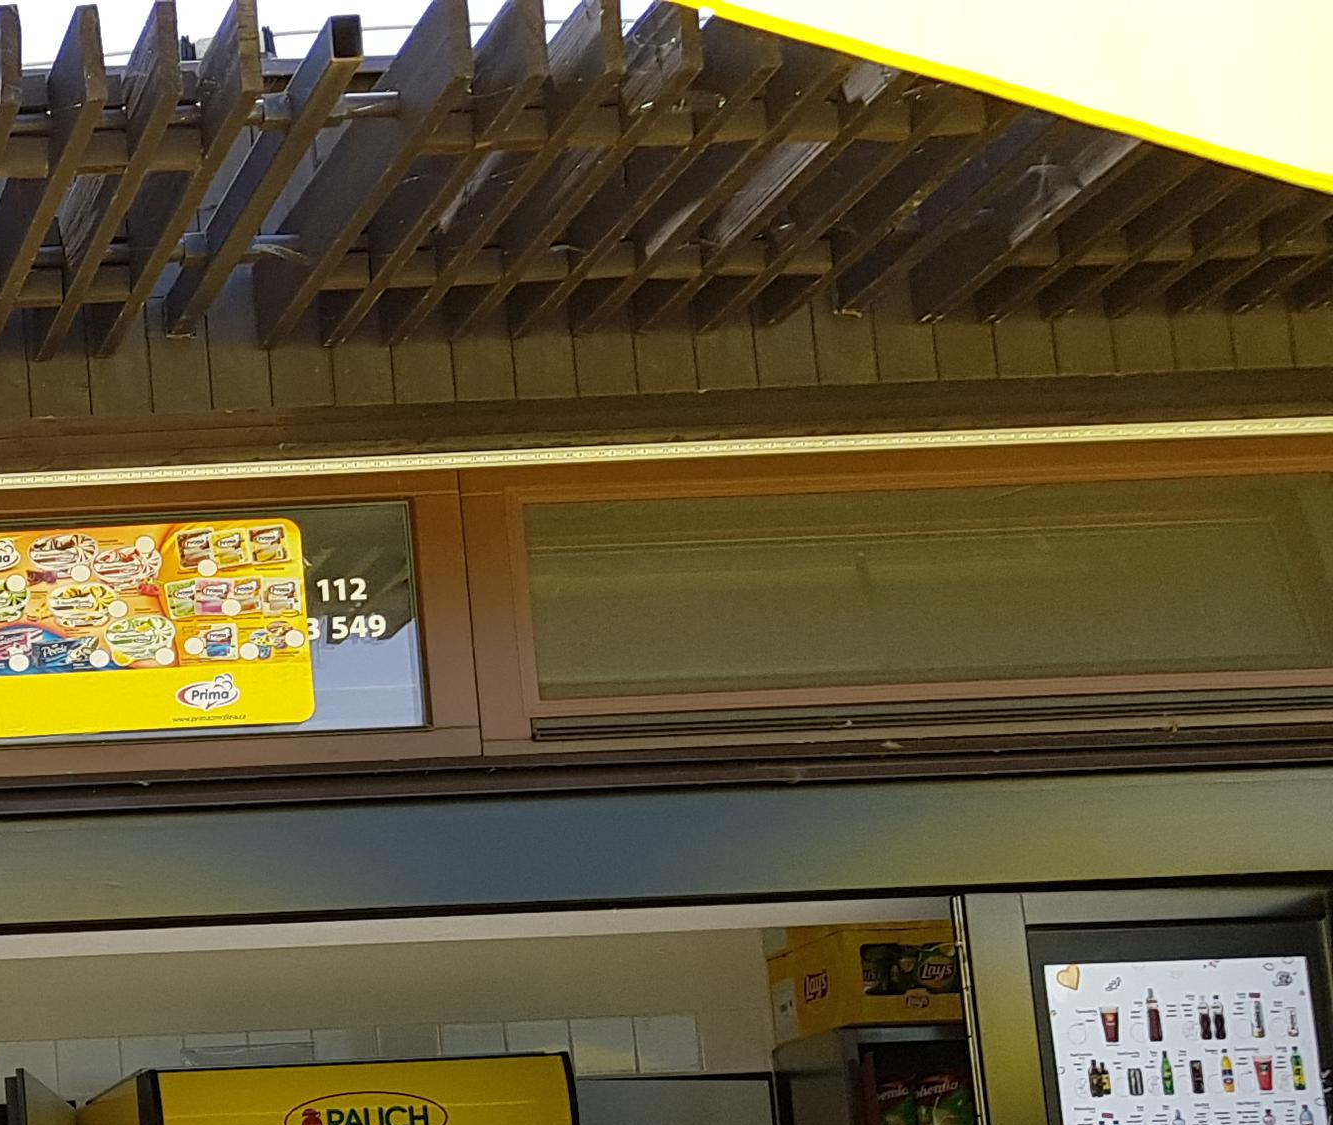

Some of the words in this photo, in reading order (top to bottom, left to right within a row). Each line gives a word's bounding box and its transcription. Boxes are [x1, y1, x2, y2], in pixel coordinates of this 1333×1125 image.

[317, 577, 368, 602] 112
[332, 614, 387, 640] 549
[191, 688, 230, 701] Prima
